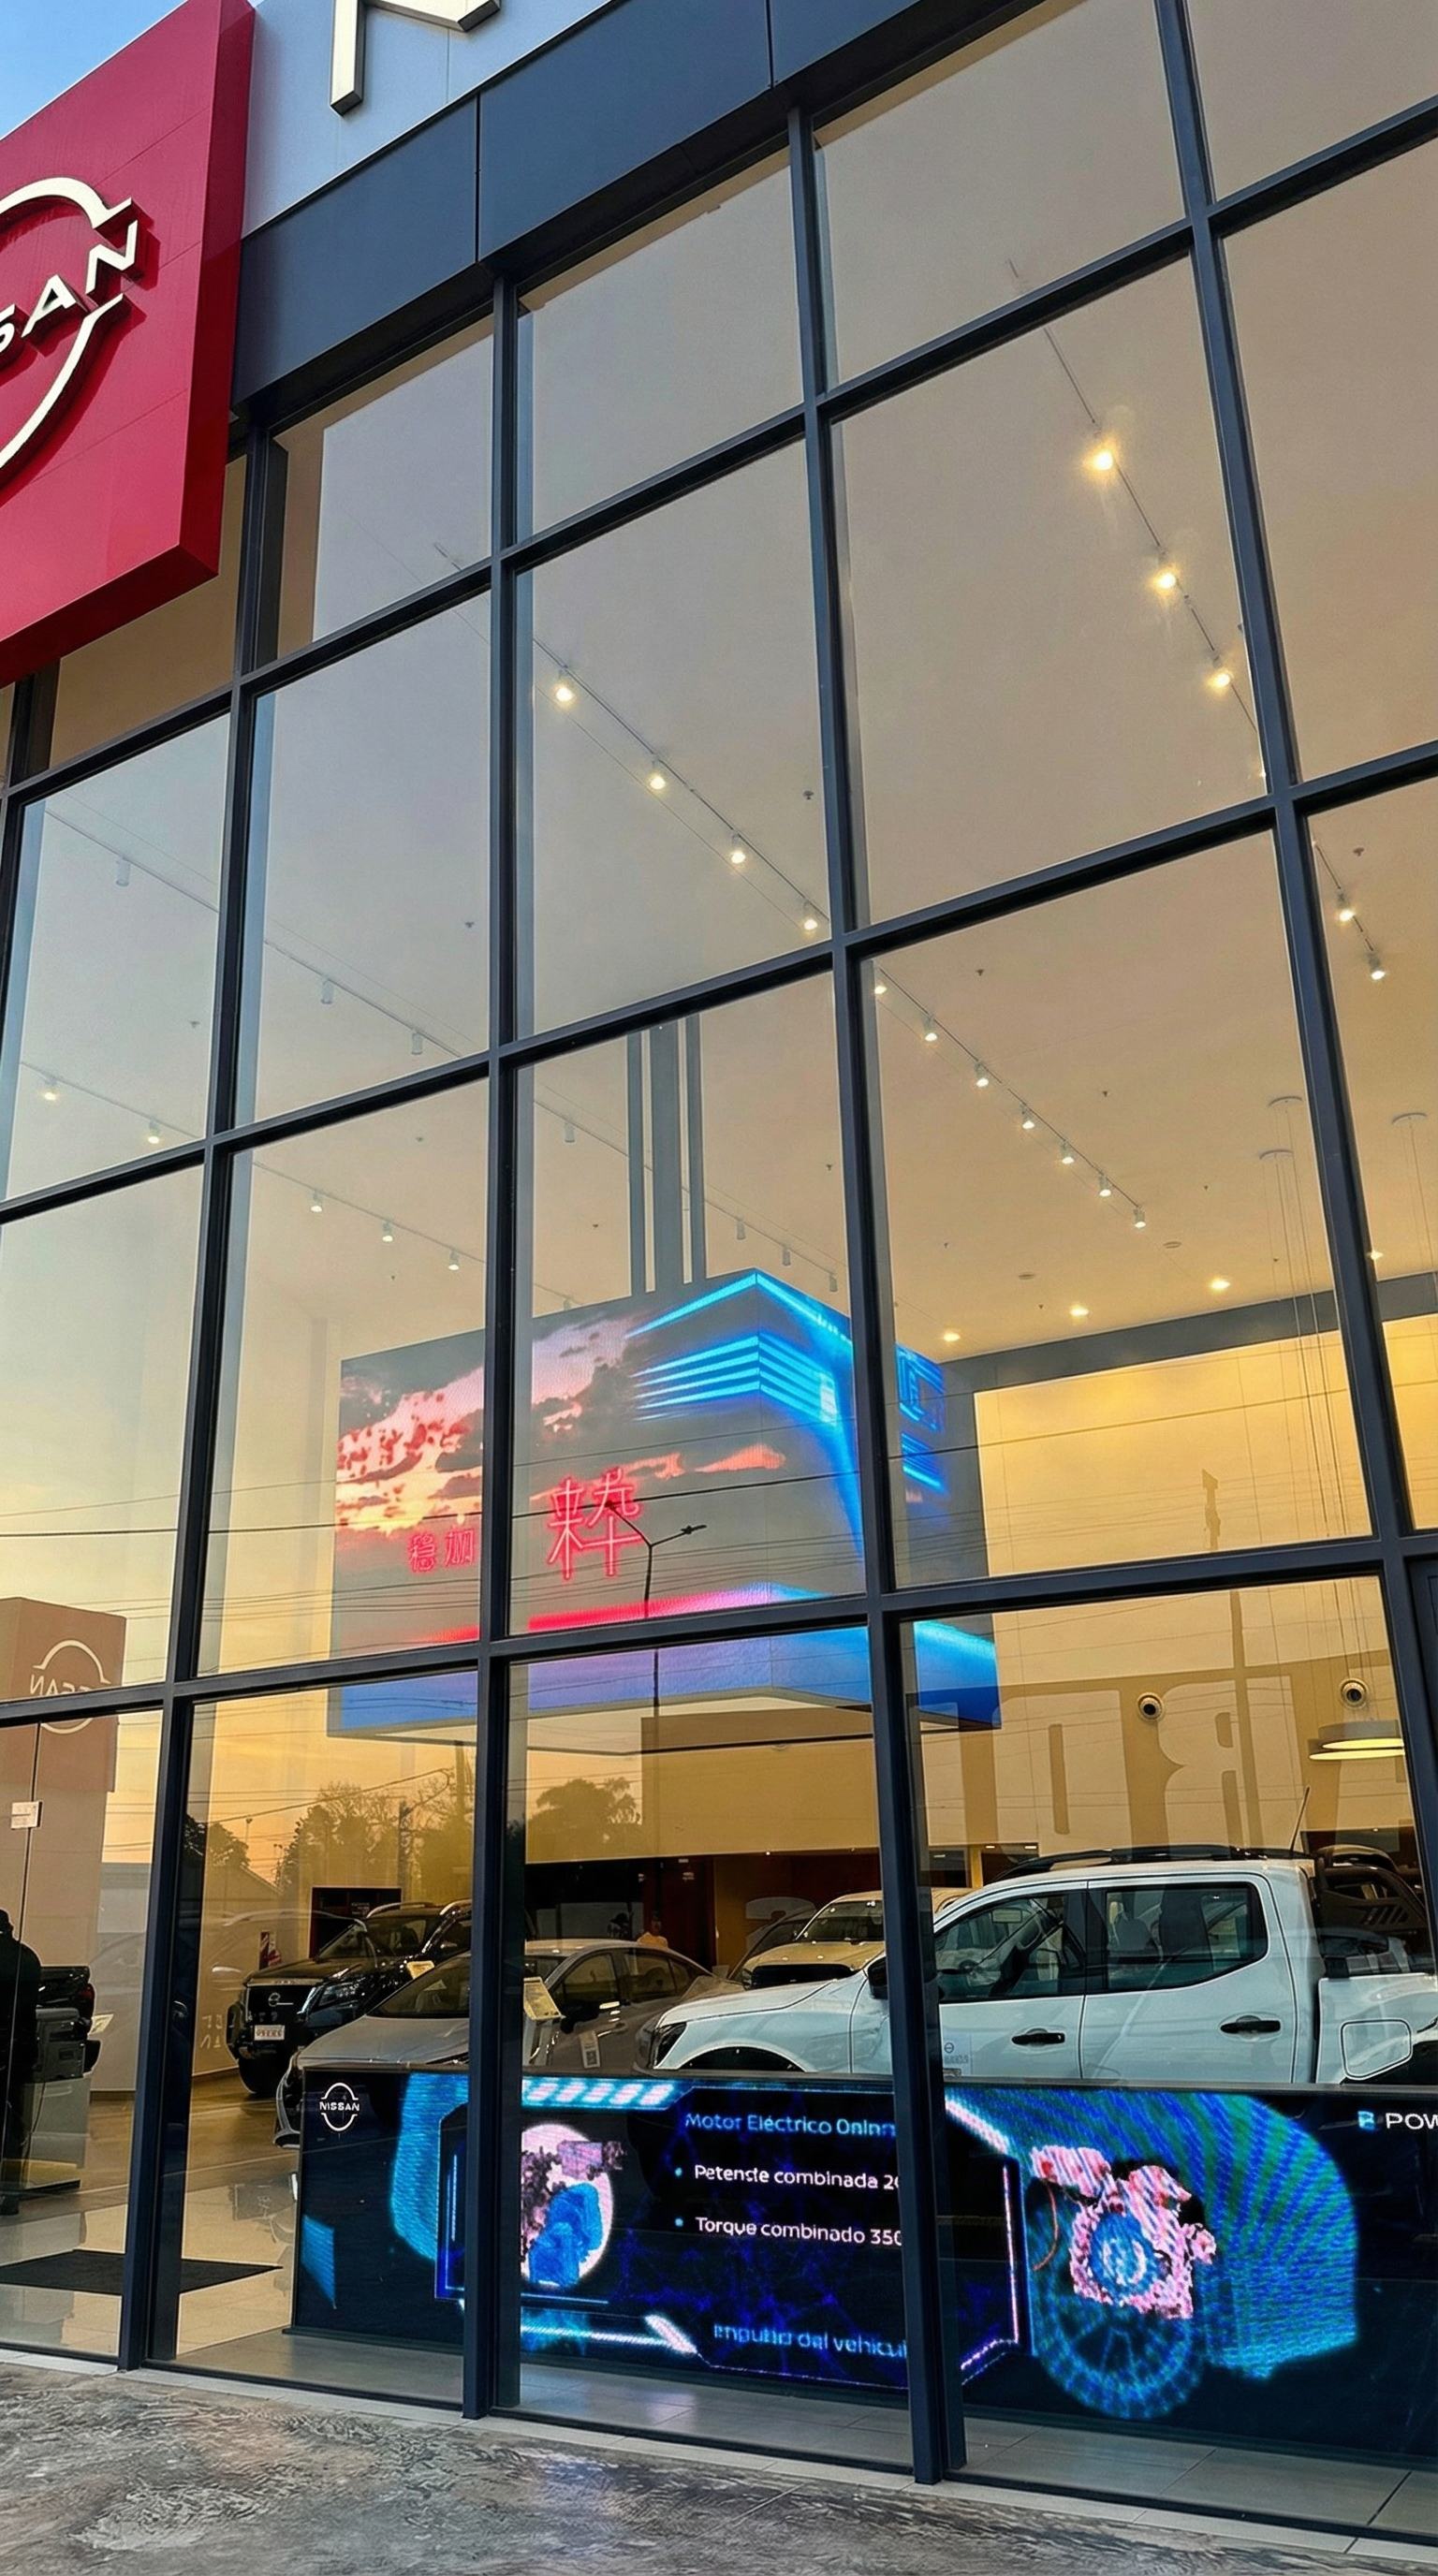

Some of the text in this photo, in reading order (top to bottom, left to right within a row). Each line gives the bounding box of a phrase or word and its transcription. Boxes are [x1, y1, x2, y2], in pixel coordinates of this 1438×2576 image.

[319, 2101, 360, 2112] NISSAN
[685, 2114, 741, 2130] Motor
[773, 2170, 878, 2188] combinada
[695, 2217, 757, 2235] Torque
[760, 2221, 866, 2244] combinado
